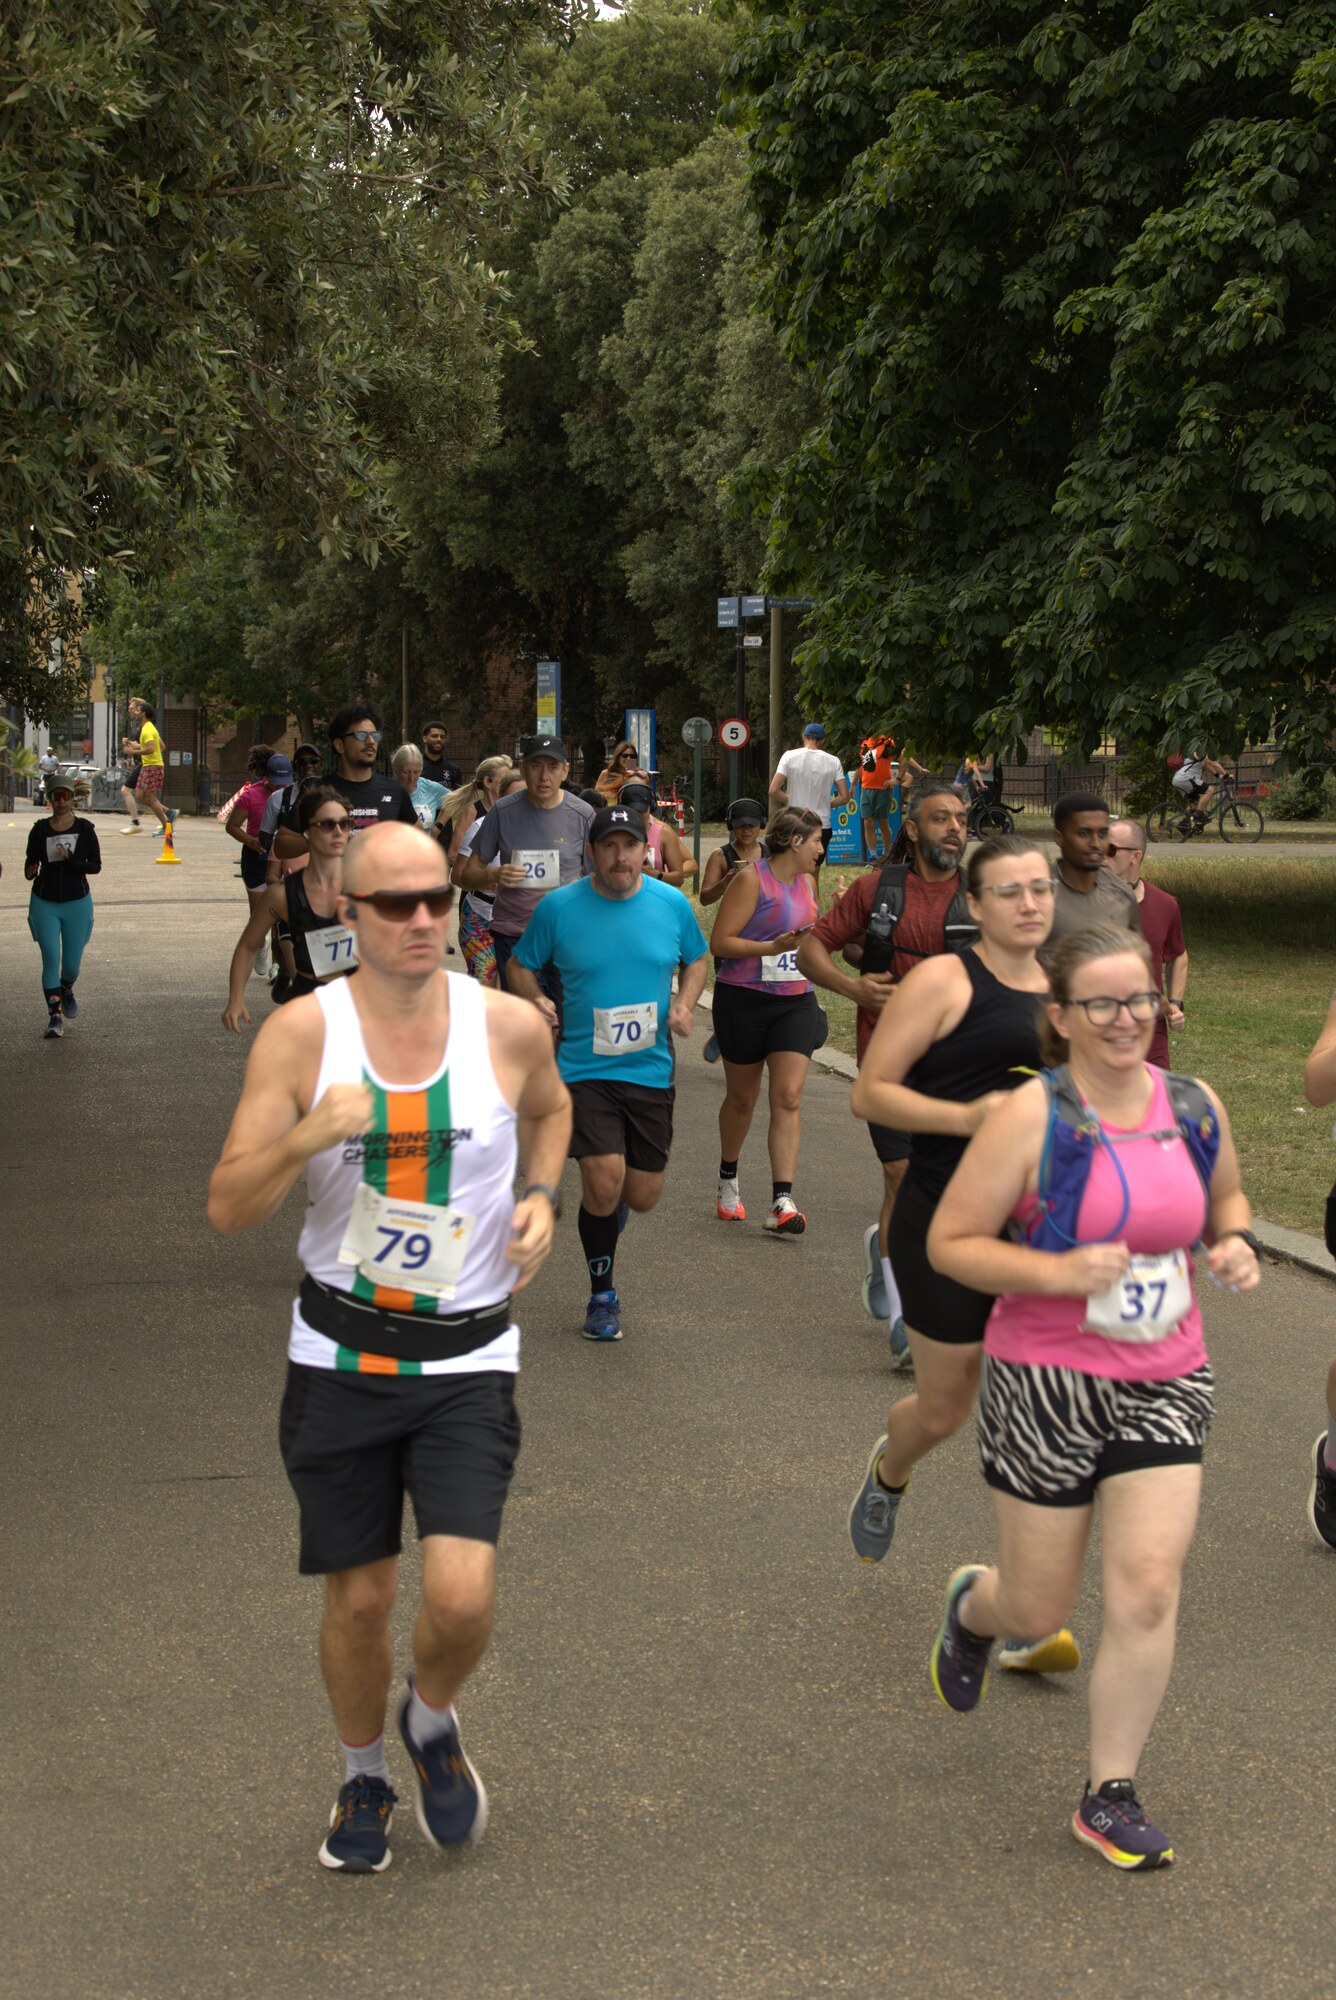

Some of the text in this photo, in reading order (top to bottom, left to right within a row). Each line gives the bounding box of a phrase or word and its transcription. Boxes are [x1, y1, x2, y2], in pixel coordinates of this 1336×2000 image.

[730, 728, 738, 740] 5
[523, 862, 546, 879] 26
[325, 937, 352, 962] 77
[611, 1020, 641, 1044] 70
[342, 1144, 428, 1162] CHASERS
[373, 1225, 432, 1270] 79
[1120, 1279, 1167, 1321] 37
